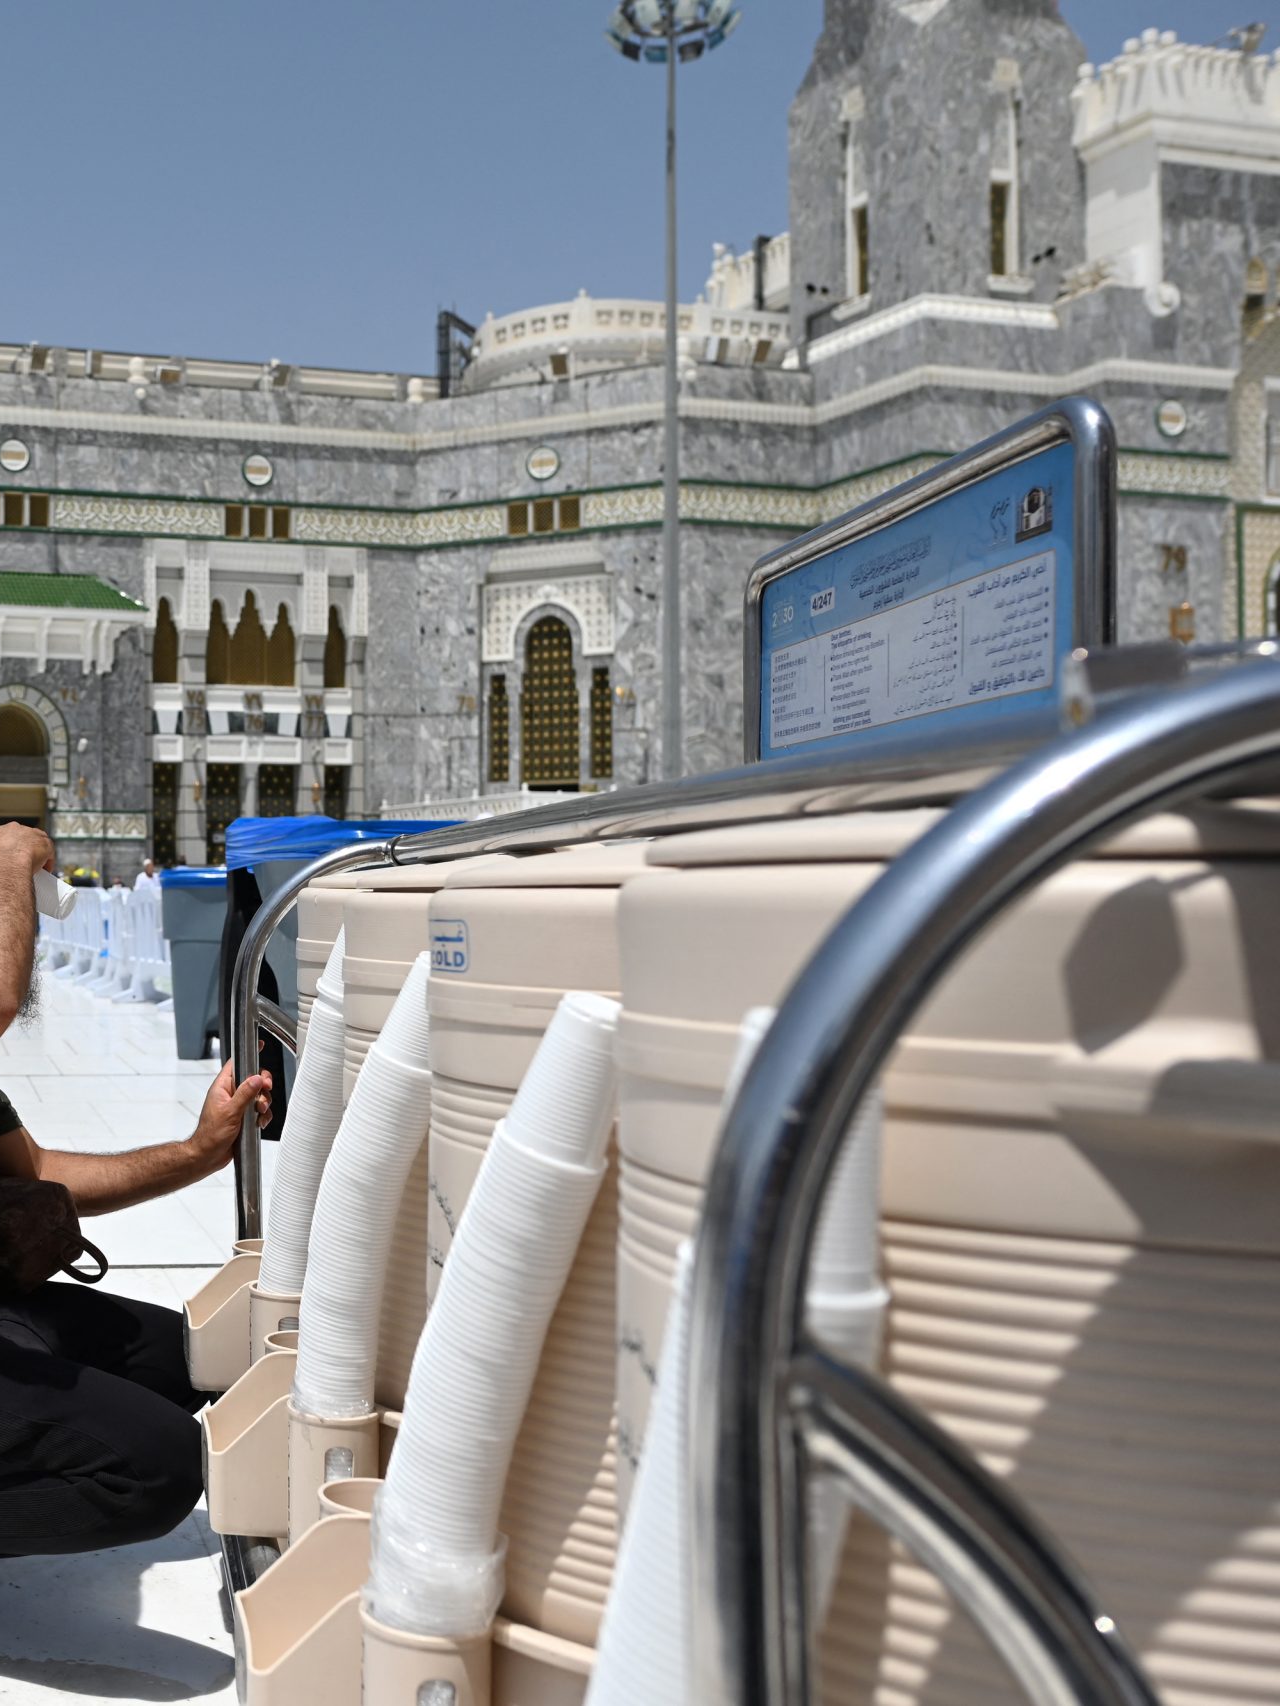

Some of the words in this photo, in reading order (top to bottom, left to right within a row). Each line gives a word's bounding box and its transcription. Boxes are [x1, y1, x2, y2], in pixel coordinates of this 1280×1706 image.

[812, 592, 832, 611] 4/247
[772, 605, 794, 628] 230
[188, 712, 204, 728] 75
